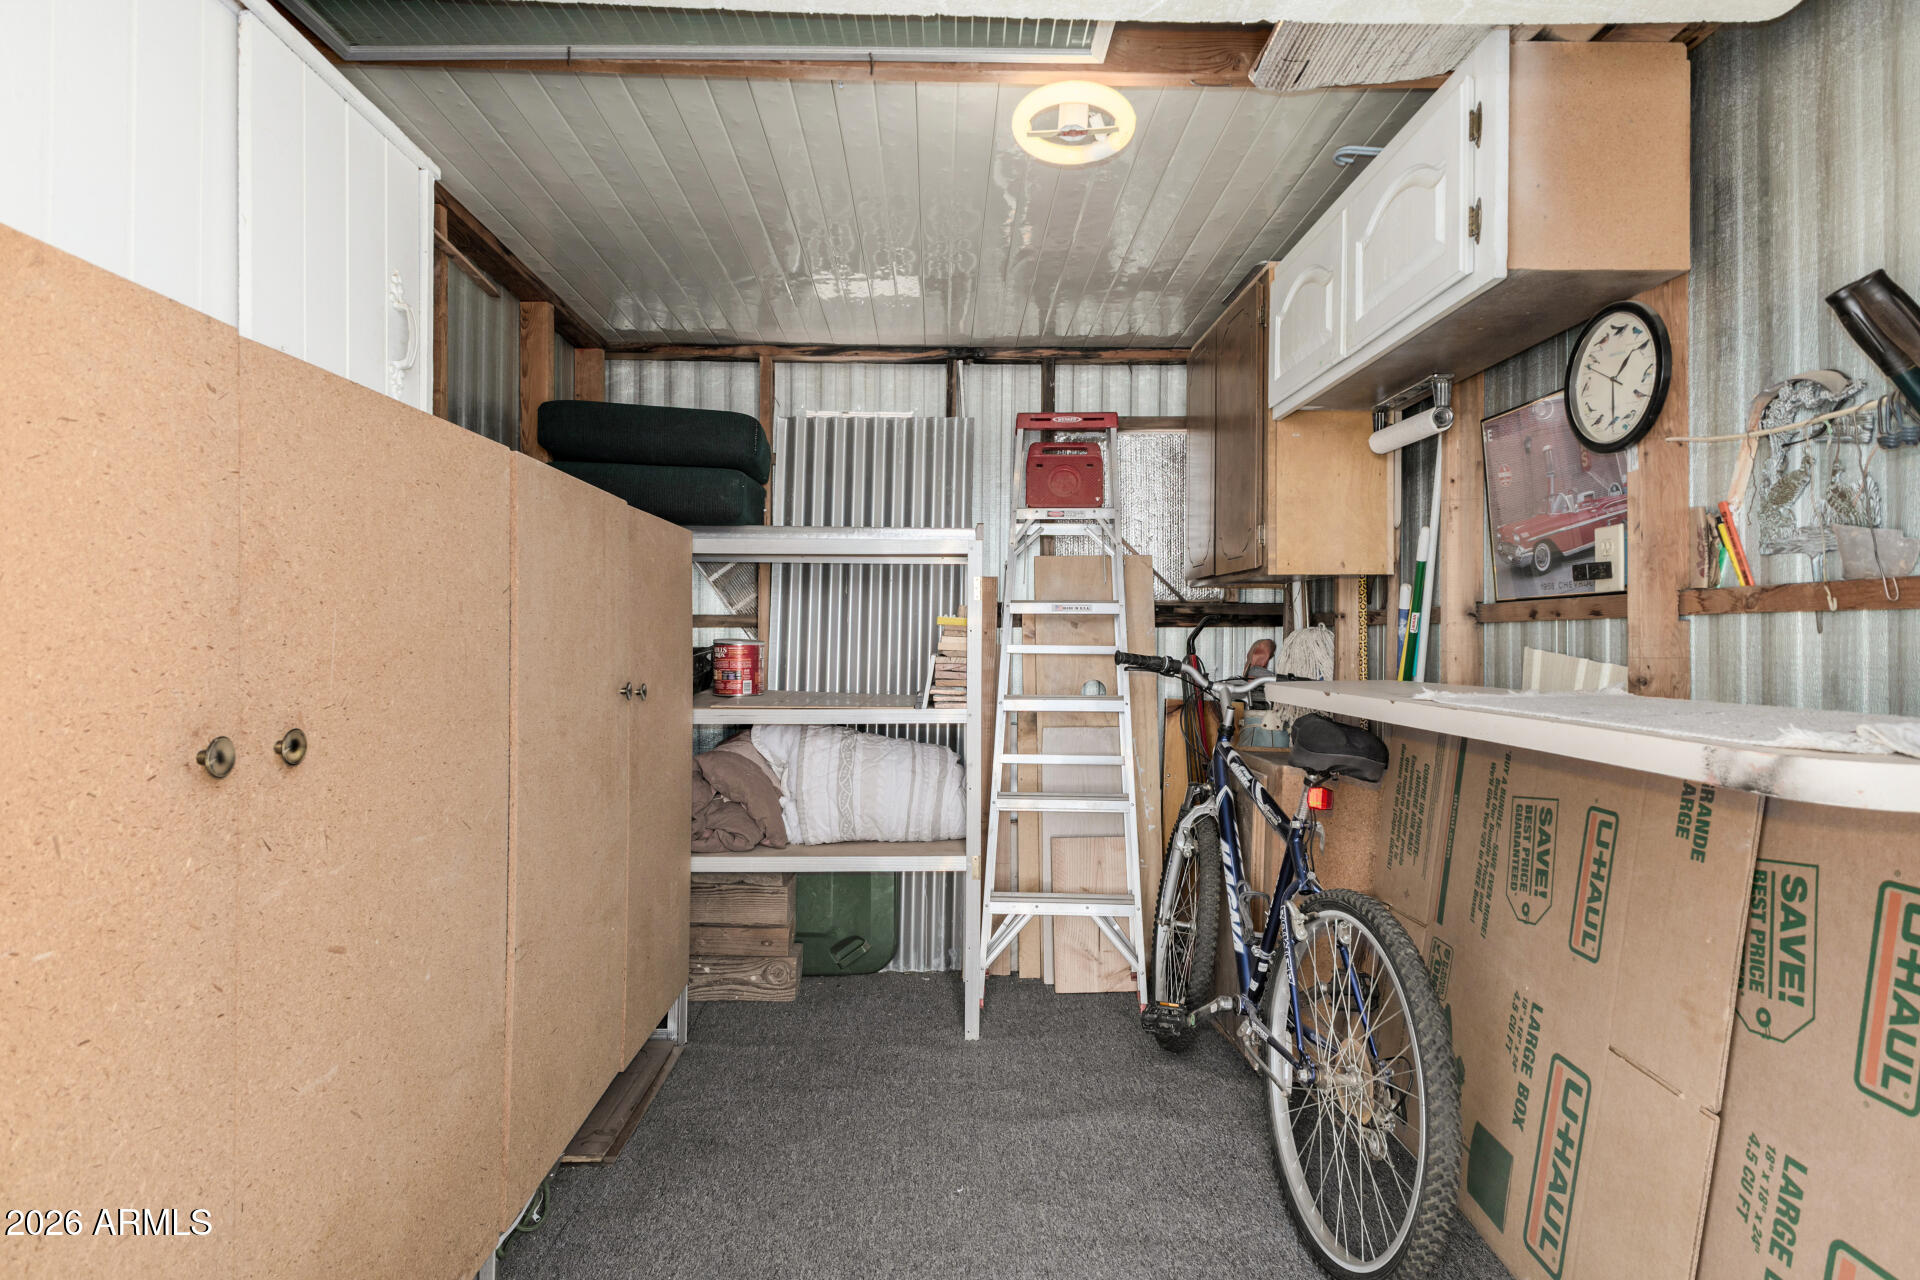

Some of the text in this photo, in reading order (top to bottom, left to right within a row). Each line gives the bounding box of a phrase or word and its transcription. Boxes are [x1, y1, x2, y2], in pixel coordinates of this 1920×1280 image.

[1418, 802, 1425, 816] UN
[1420, 763, 1430, 801] COMPRE
[1502, 776, 1508, 784] A
[1676, 780, 1697, 840] ARGE
[1447, 794, 1458, 860] uhaul.com
[1519, 804, 1533, 893] BEST PRICE
[1534, 806, 1553, 899] SAVE!
[1220, 838, 1244, 954] MAGNA
[1481, 859, 1489, 889] Prices
[1486, 872, 1495, 901] EVEN
[1581, 819, 1613, 947] U-HAUL
[1480, 902, 1490, 939] MORE!
[1749, 870, 1767, 994] BEST PRICE
[1778, 874, 1809, 1007] SAVE!
[1505, 991, 1522, 1055] 4.5 CU FT
[1510, 1002, 1544, 1133] LARGE BOX
[1539, 1078, 1583, 1250] U-HAUL
[1735, 1131, 1761, 1224] 4.5 CU FT
[1748, 1143, 1778, 1256] 18" x 18" x 24"
[1767, 1153, 1809, 1269] LARGE
